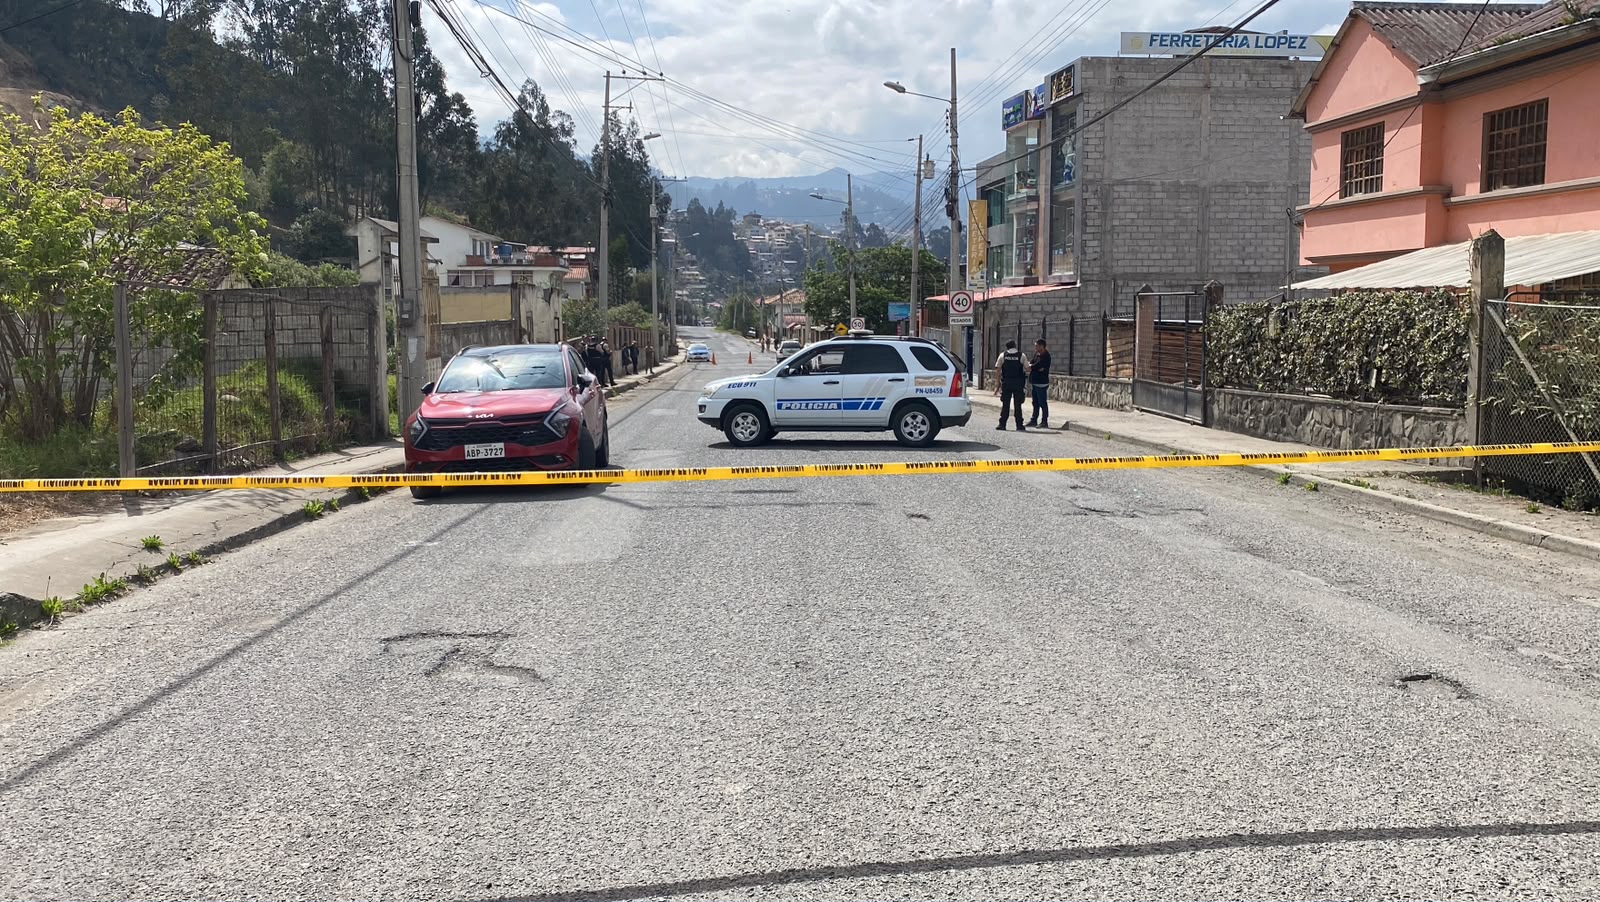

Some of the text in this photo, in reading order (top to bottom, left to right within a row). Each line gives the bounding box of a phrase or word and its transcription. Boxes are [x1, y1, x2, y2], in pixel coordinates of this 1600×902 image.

[1254, 35, 1309, 49] LOPEZ
[955, 298, 968, 307] 40
[781, 402, 838, 410] POLICIA
[466, 448, 503, 457] ABP-3727
